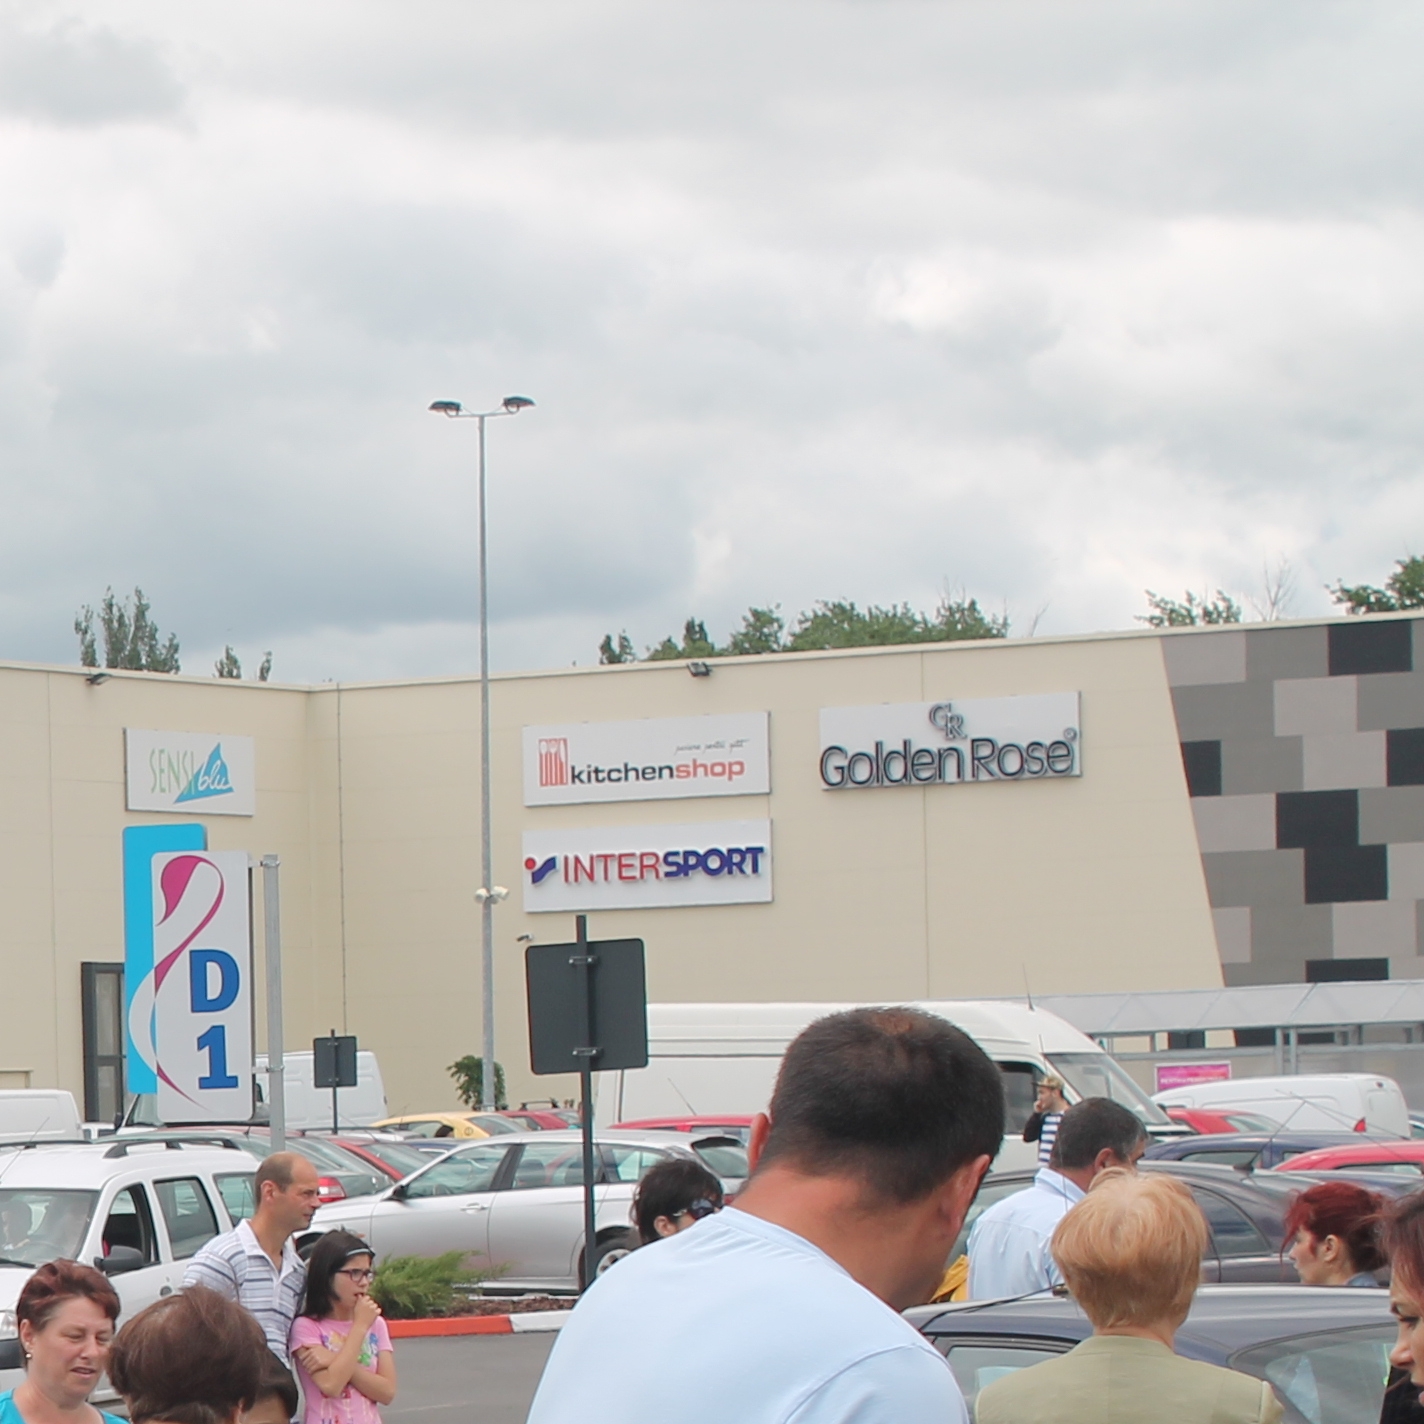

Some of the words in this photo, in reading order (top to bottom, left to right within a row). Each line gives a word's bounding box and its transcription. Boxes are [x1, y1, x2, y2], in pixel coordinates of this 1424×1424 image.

[570, 758, 745, 786] kitchenshop
[820, 738, 963, 788] Golden
[970, 737, 1075, 778] Rose
[563, 846, 765, 883] INTERSPORT
[189, 949, 240, 1014] D
[197, 1025, 239, 1090] 1
